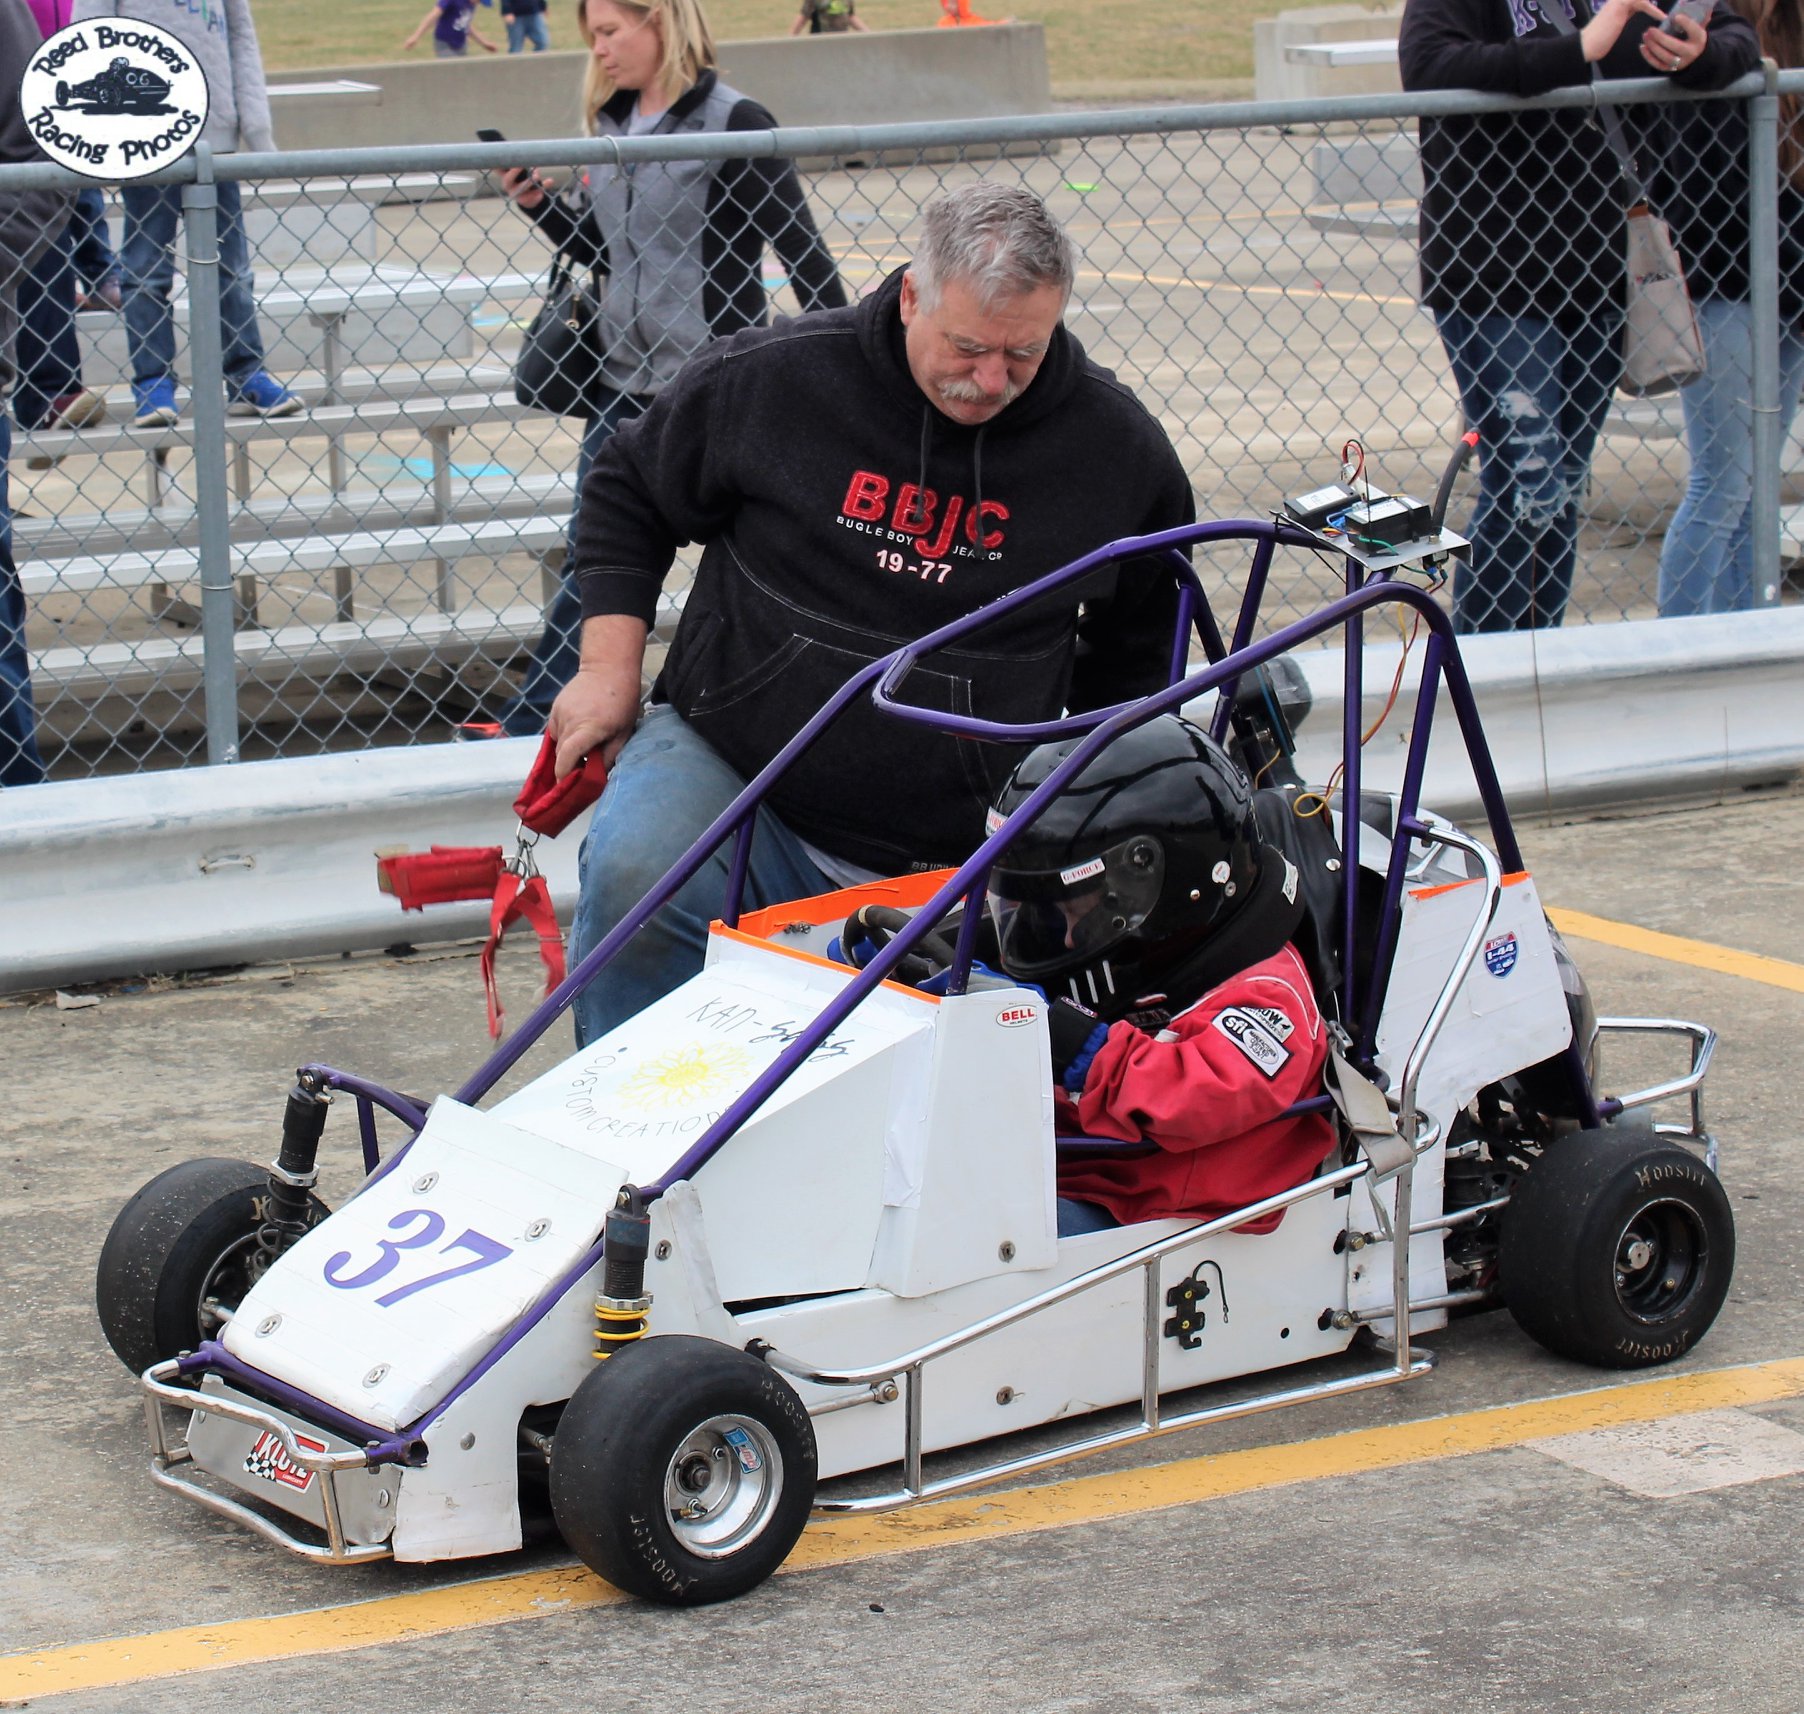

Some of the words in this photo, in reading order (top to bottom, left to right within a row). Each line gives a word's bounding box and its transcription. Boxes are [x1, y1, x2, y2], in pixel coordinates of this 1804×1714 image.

[841, 469, 1011, 559] BBJC
[836, 515, 883, 537] BUGLE
[886, 530, 914, 546] BOY
[952, 545, 986, 561] JEA
[875, 549, 953, 584] 19-77
[1001, 1007, 1035, 1022] BELL
[323, 1208, 515, 1308] 37
